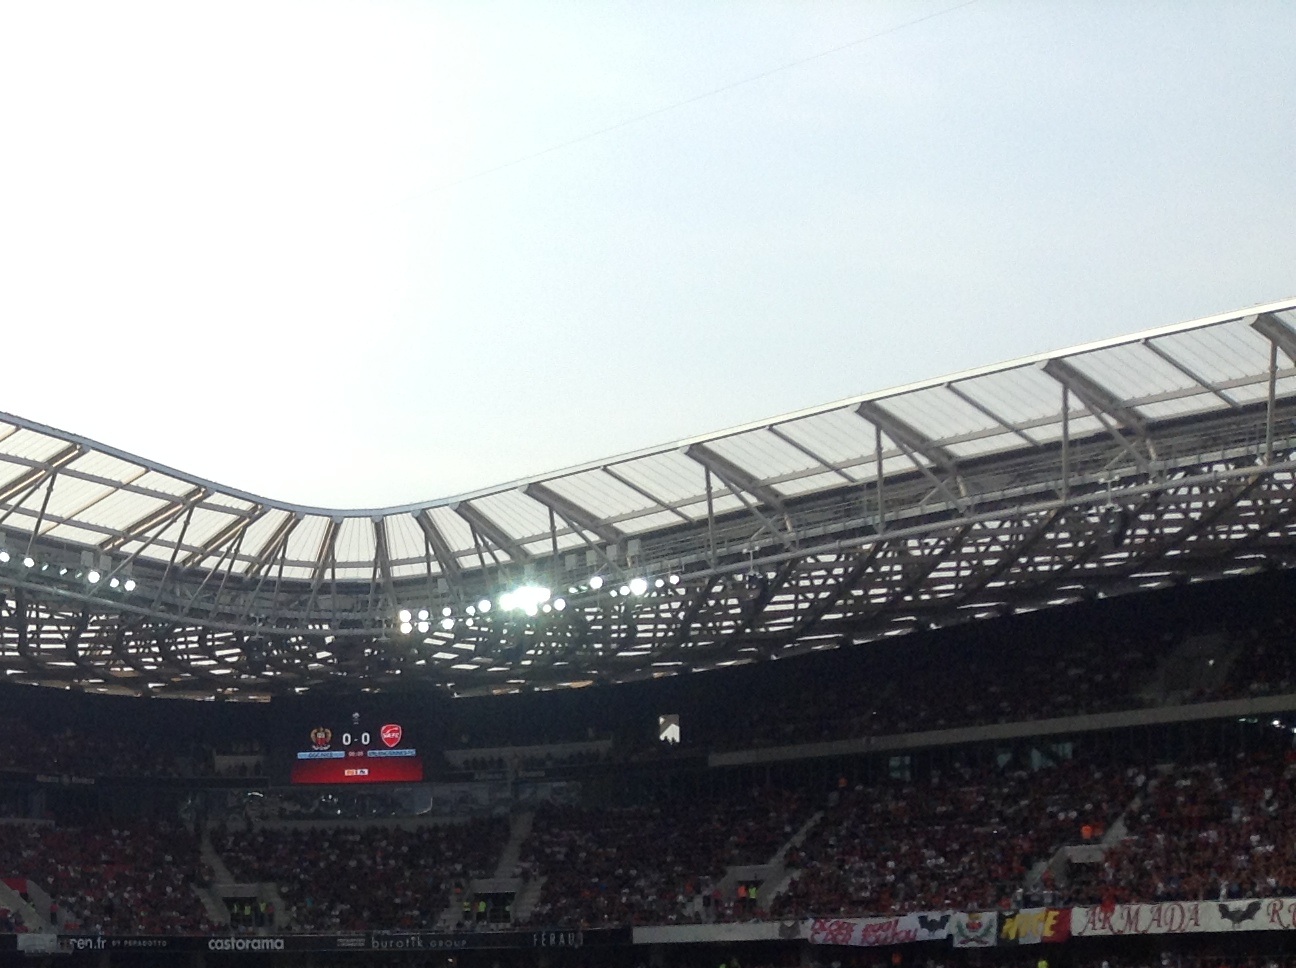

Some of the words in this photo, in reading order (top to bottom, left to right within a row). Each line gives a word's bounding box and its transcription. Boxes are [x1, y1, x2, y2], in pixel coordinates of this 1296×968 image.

[342, 732, 352, 746] 0
[361, 731, 371, 745] 0
[1078, 901, 1201, 936] ARMADA
[208, 937, 284, 950] castorama
